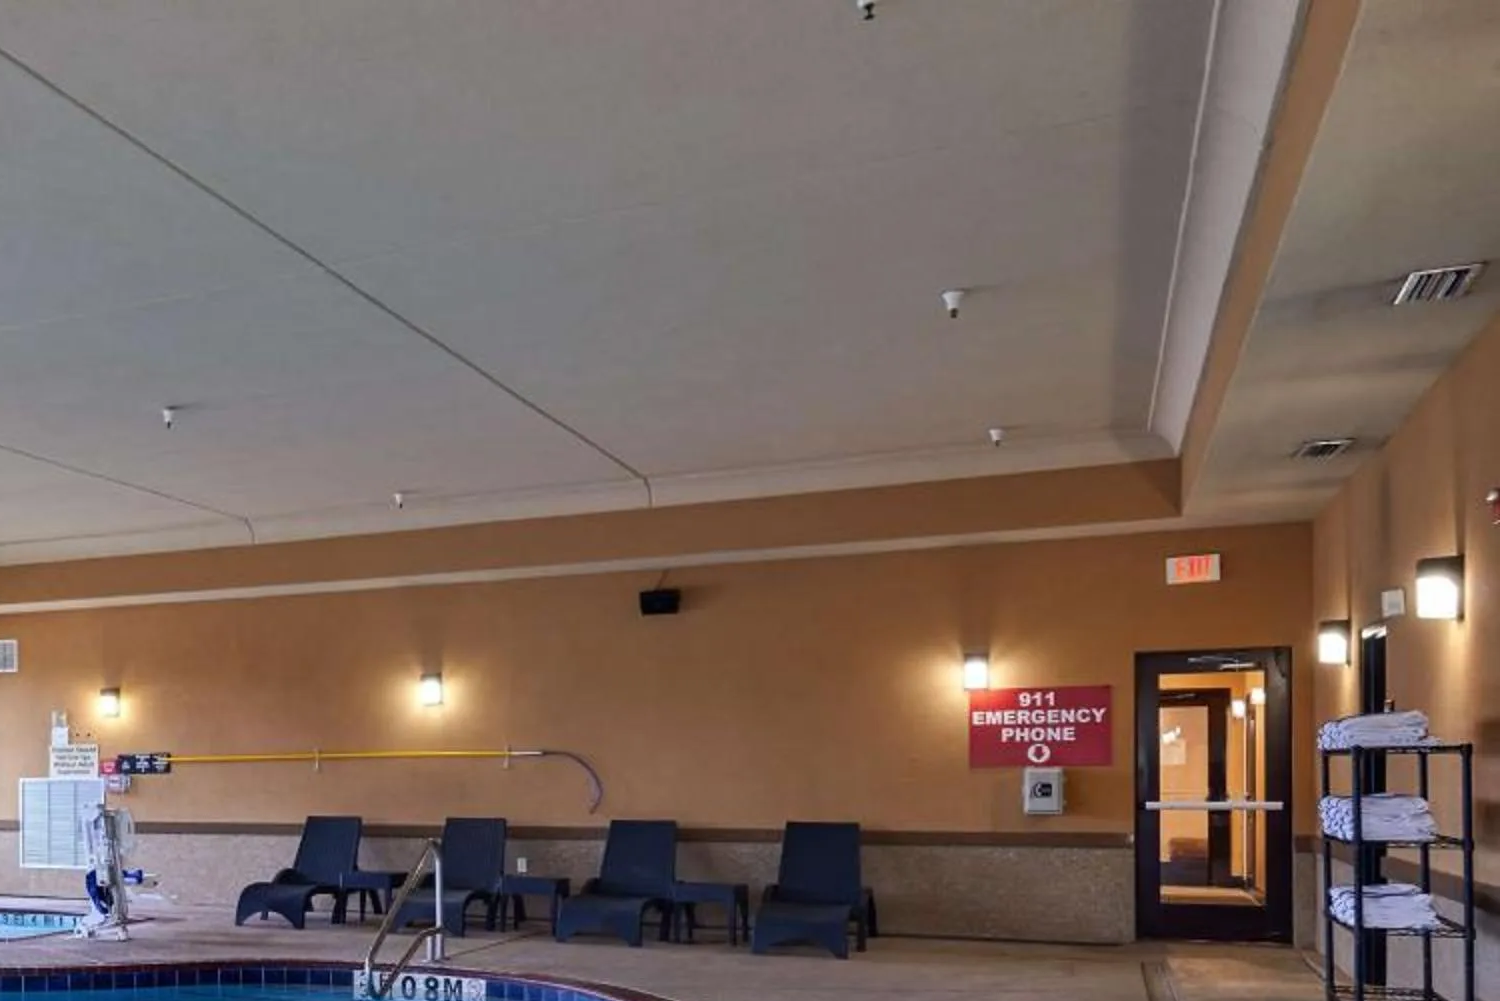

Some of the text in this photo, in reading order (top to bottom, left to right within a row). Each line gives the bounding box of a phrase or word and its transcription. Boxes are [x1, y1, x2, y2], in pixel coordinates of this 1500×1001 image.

[1018, 691, 1056, 707] 911
[972, 708, 1107, 725] EMERGENCY
[1001, 726, 1077, 743] PHONE
